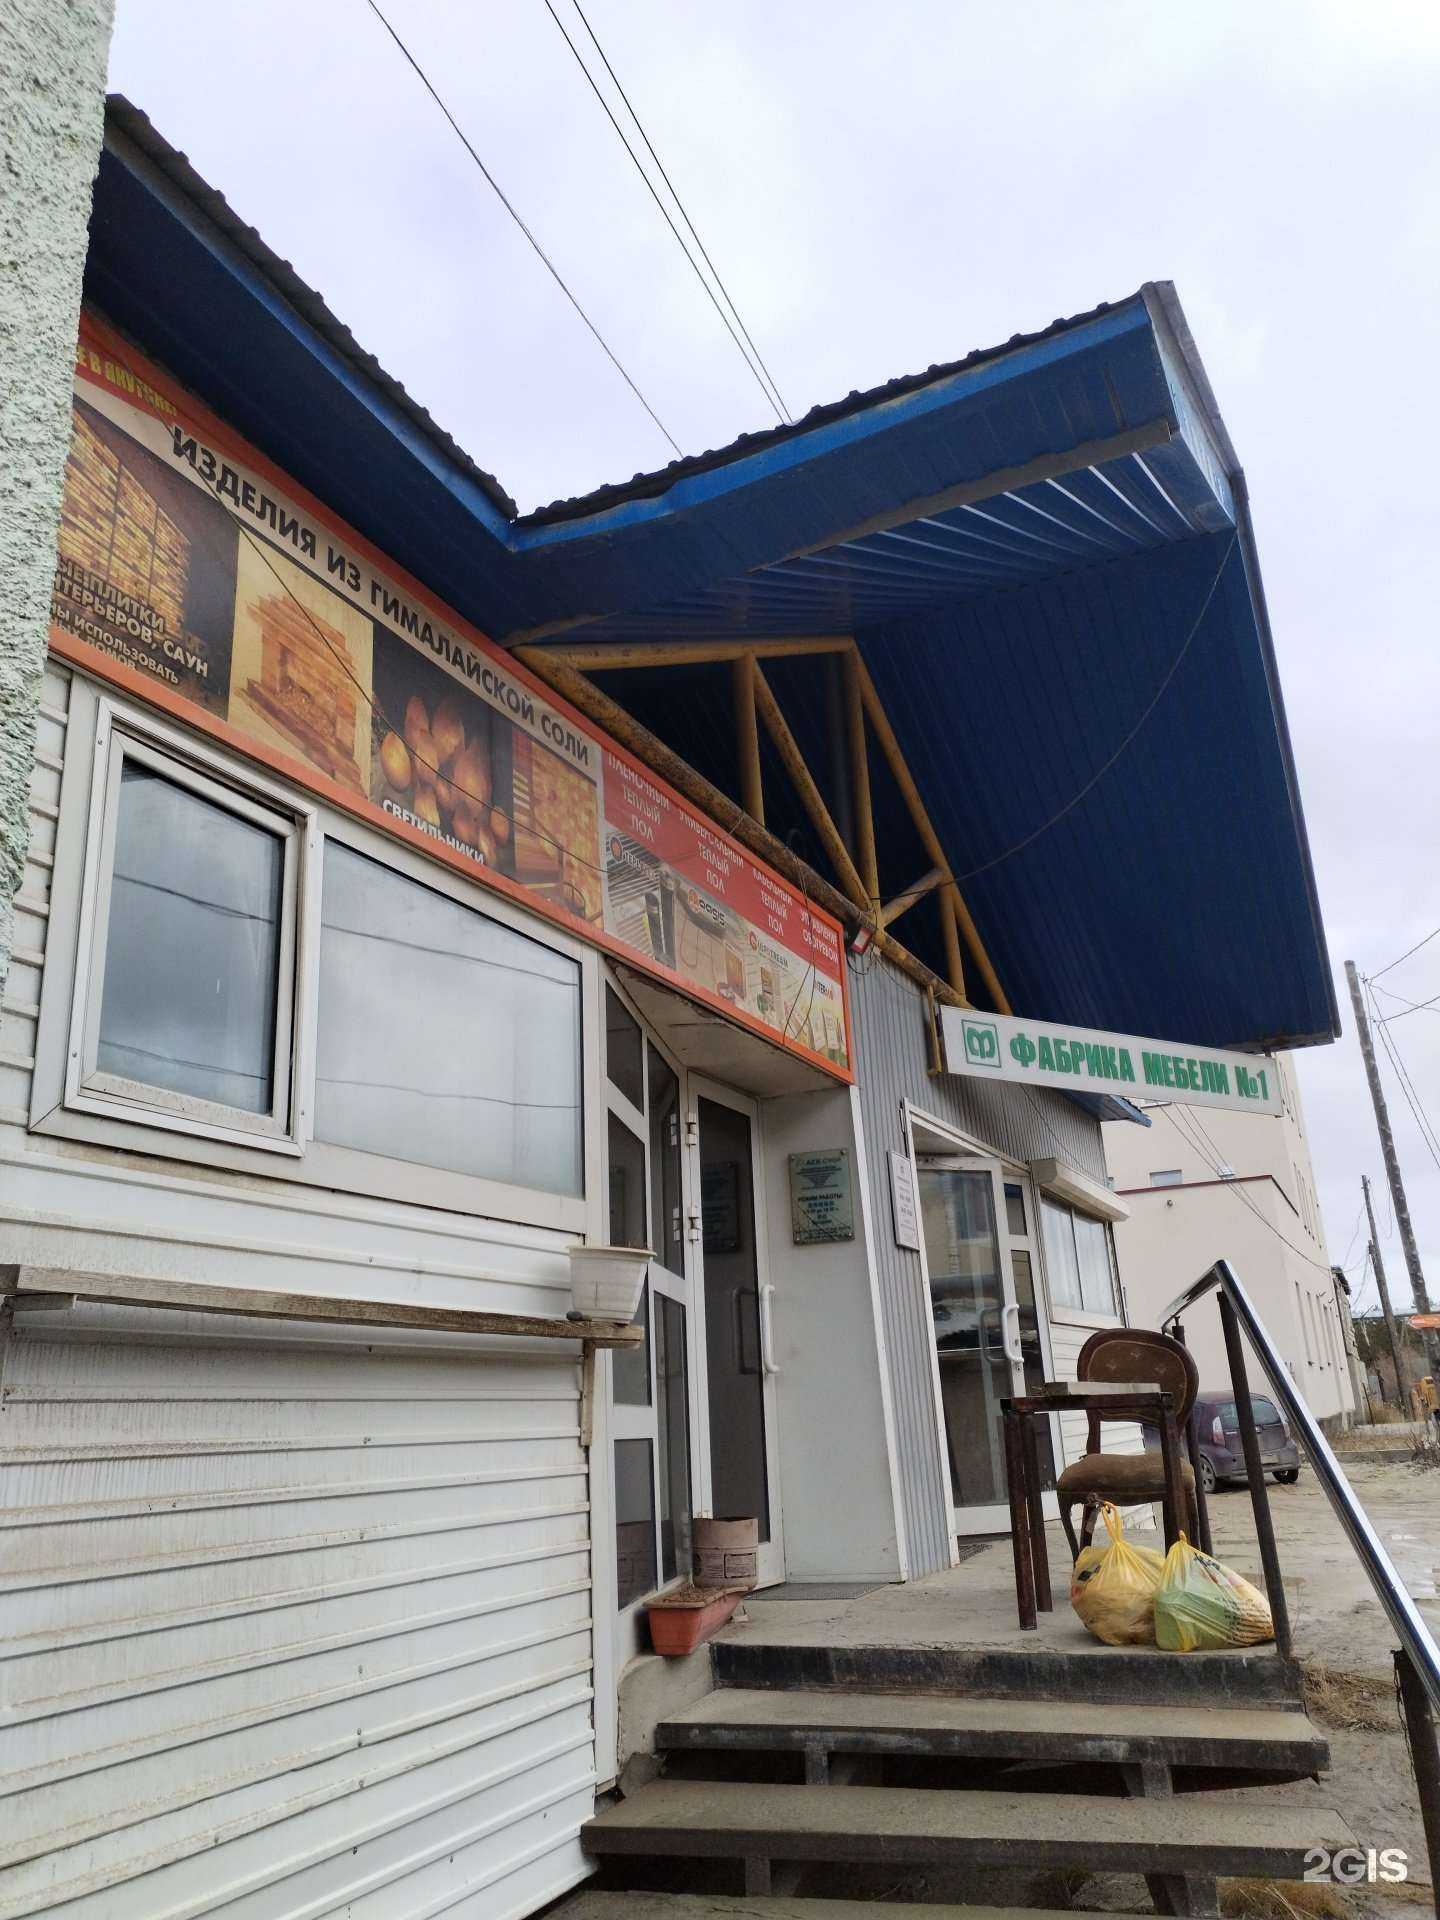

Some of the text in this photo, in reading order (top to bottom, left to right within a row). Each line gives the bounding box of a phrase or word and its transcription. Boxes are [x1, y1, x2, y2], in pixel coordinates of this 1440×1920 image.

[89, 574, 166, 633] ПЛИТКИ
[172, 426, 589, 767] ИЗДЕЛИЯ ИЗ ГИМАЛАЙСКОЙ СОЛИ
[74, 614, 180, 685] ИСПОЛЬЗОВАТЬ
[163, 639, 208, 677] САУН
[623, 783, 661, 825] ТЕПЛЫЙ
[383, 799, 484, 865] СВЕТИЛЬНИКИ
[631, 814, 655, 842] ПОЛ
[697, 840, 730, 877] ТЕПЛЫЙ
[706, 869, 726, 894] ПОЛ
[761, 889, 788, 921] ТЕПЛЫЙ
[768, 913, 785, 937] ПОЛ
[1009, 1033, 1269, 1100] ФАБРИКА МЕБЕЛИ №1
